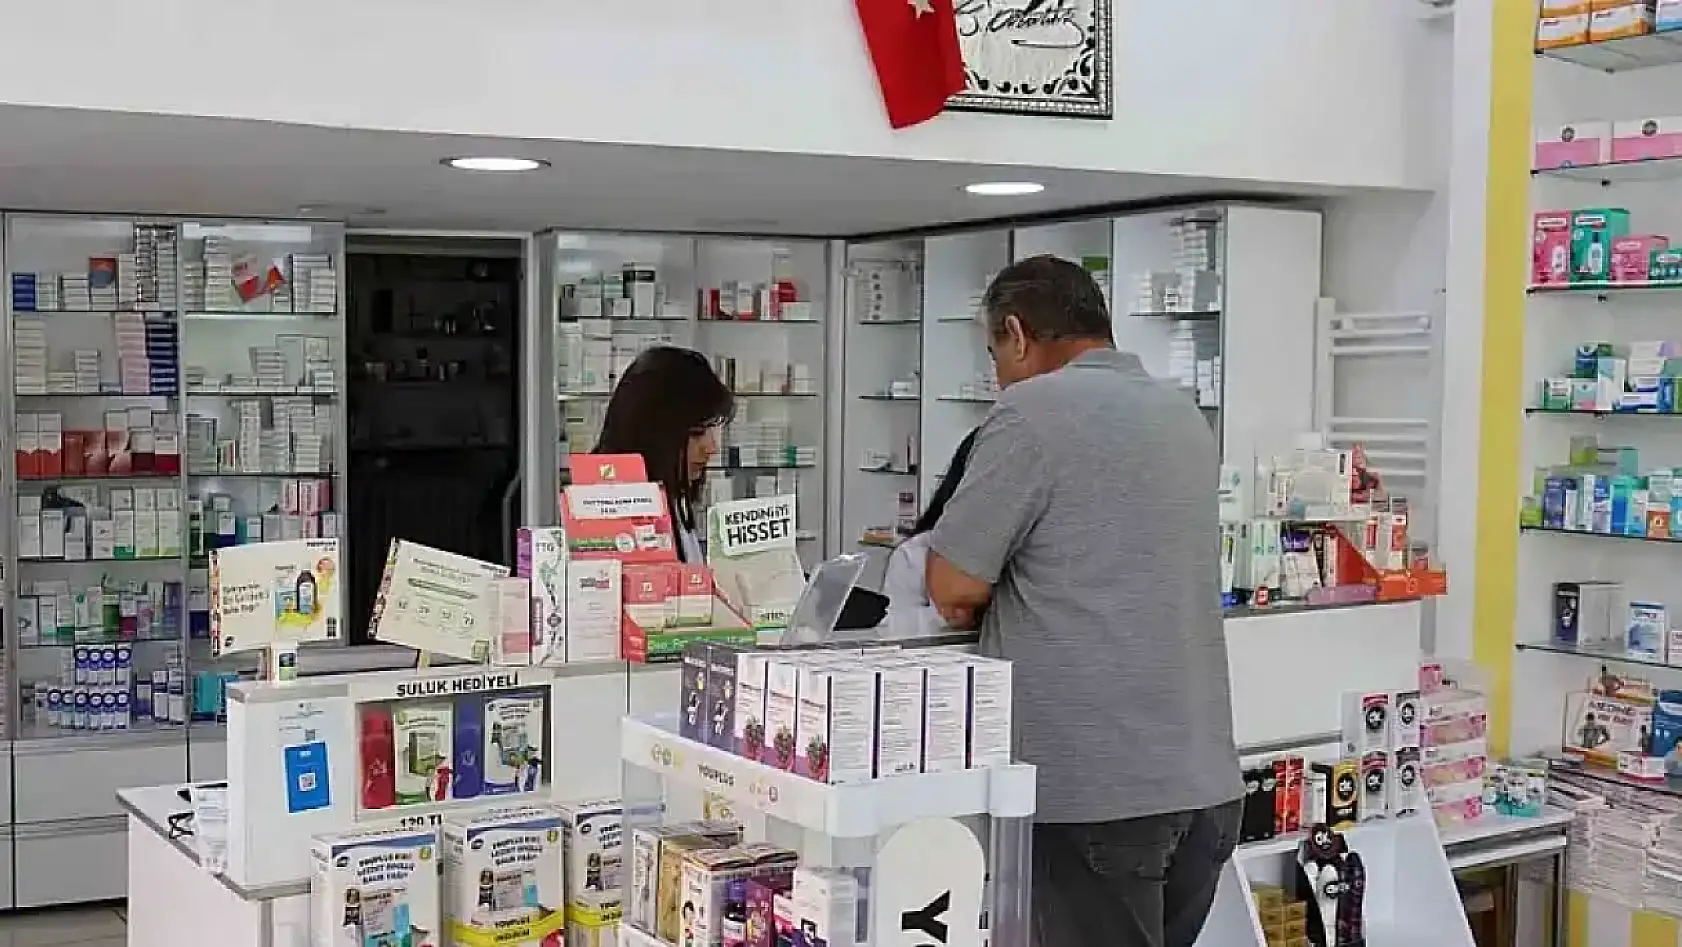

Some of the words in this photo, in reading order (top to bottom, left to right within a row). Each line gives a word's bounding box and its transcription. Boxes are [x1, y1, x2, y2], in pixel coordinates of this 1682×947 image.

[727, 518, 791, 547] HİSSET
[396, 680, 448, 697] SULUK
[452, 671, 519, 691] HEDİYELİ
[901, 889, 951, 947] Y
